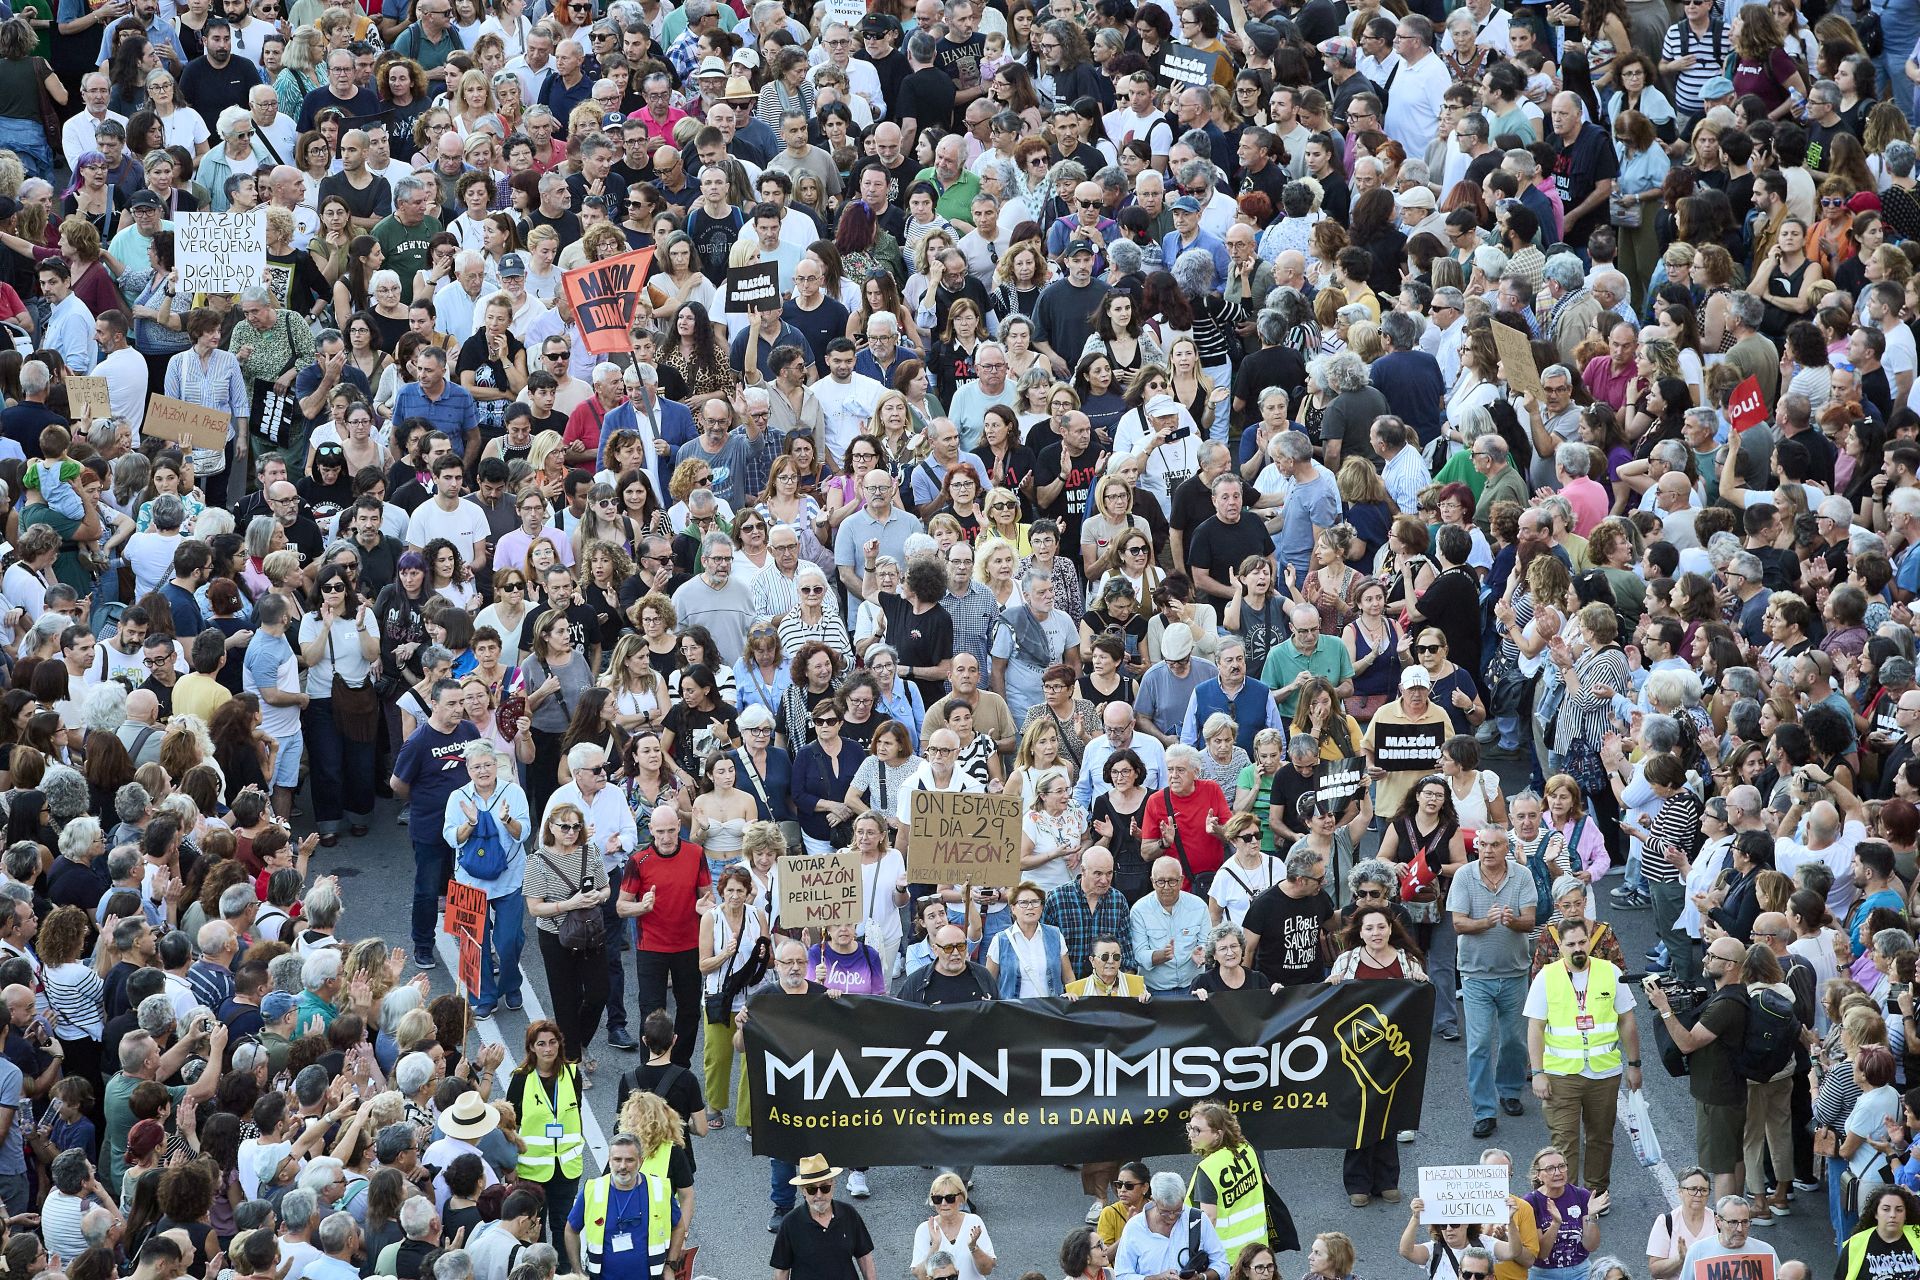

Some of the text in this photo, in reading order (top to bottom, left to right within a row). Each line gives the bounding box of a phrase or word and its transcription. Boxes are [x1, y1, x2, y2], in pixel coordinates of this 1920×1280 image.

[941, 43, 980, 66] HAWAII
[1165, 54, 1207, 74] MAZÓN
[1160, 65, 1208, 86] DIMISSIÓ
[188, 212, 256, 227] MAZON
[179, 240, 262, 253] VERGUENZA
[697, 242, 733, 254] IDENTIT
[214, 252, 230, 265] NI
[185, 264, 255, 278] DIGNIDAD
[183, 278, 231, 292] DIMITE
[737, 274, 771, 291] MAZÓN
[731, 284, 777, 302] DIMISSIÓ
[151, 401, 188, 424] MAZÓN
[191, 413, 199, 427] A
[1731, 391, 1760, 419] ou!
[1385, 734, 1436, 748] MAZÓN
[1378, 746, 1442, 760] DIMISSIÓ
[1319, 769, 1361, 788] MAZÓN
[915, 793, 1020, 818] ON ESTAVES
[913, 818, 933, 837] EL
[788, 856, 840, 873] VOTAR A
[801, 867, 854, 889] MAZÓN
[449, 882, 486, 915] PICANYA
[841, 886, 857, 898] DE
[806, 901, 857, 922] MORT
[1284, 915, 1319, 935] EL POBLE
[1284, 929, 1311, 950] SALVA
[1284, 949, 1297, 965] AL
[764, 1016, 1328, 1100] MAZÓN DIMISSIÓ
[768, 1106, 883, 1128] Associació
[892, 1107, 992, 1125] Víctimes
[1003, 1108, 1029, 1125] de
[1039, 1108, 1058, 1125] la
[1070, 1108, 1133, 1126] DANA
[1143, 1108, 1170, 1125] 29
[1278, 1092, 1334, 1110] 2024
[1219, 1149, 1253, 1189] CNT
[1235, 1172, 1258, 1199] LUCHA
[1446, 1181, 1491, 1190] POR TODAS
[1436, 1192, 1454, 1200] LAS
[1441, 1203, 1496, 1216] JUSTICIA
[1706, 1255, 1764, 1280] MAZÓN
